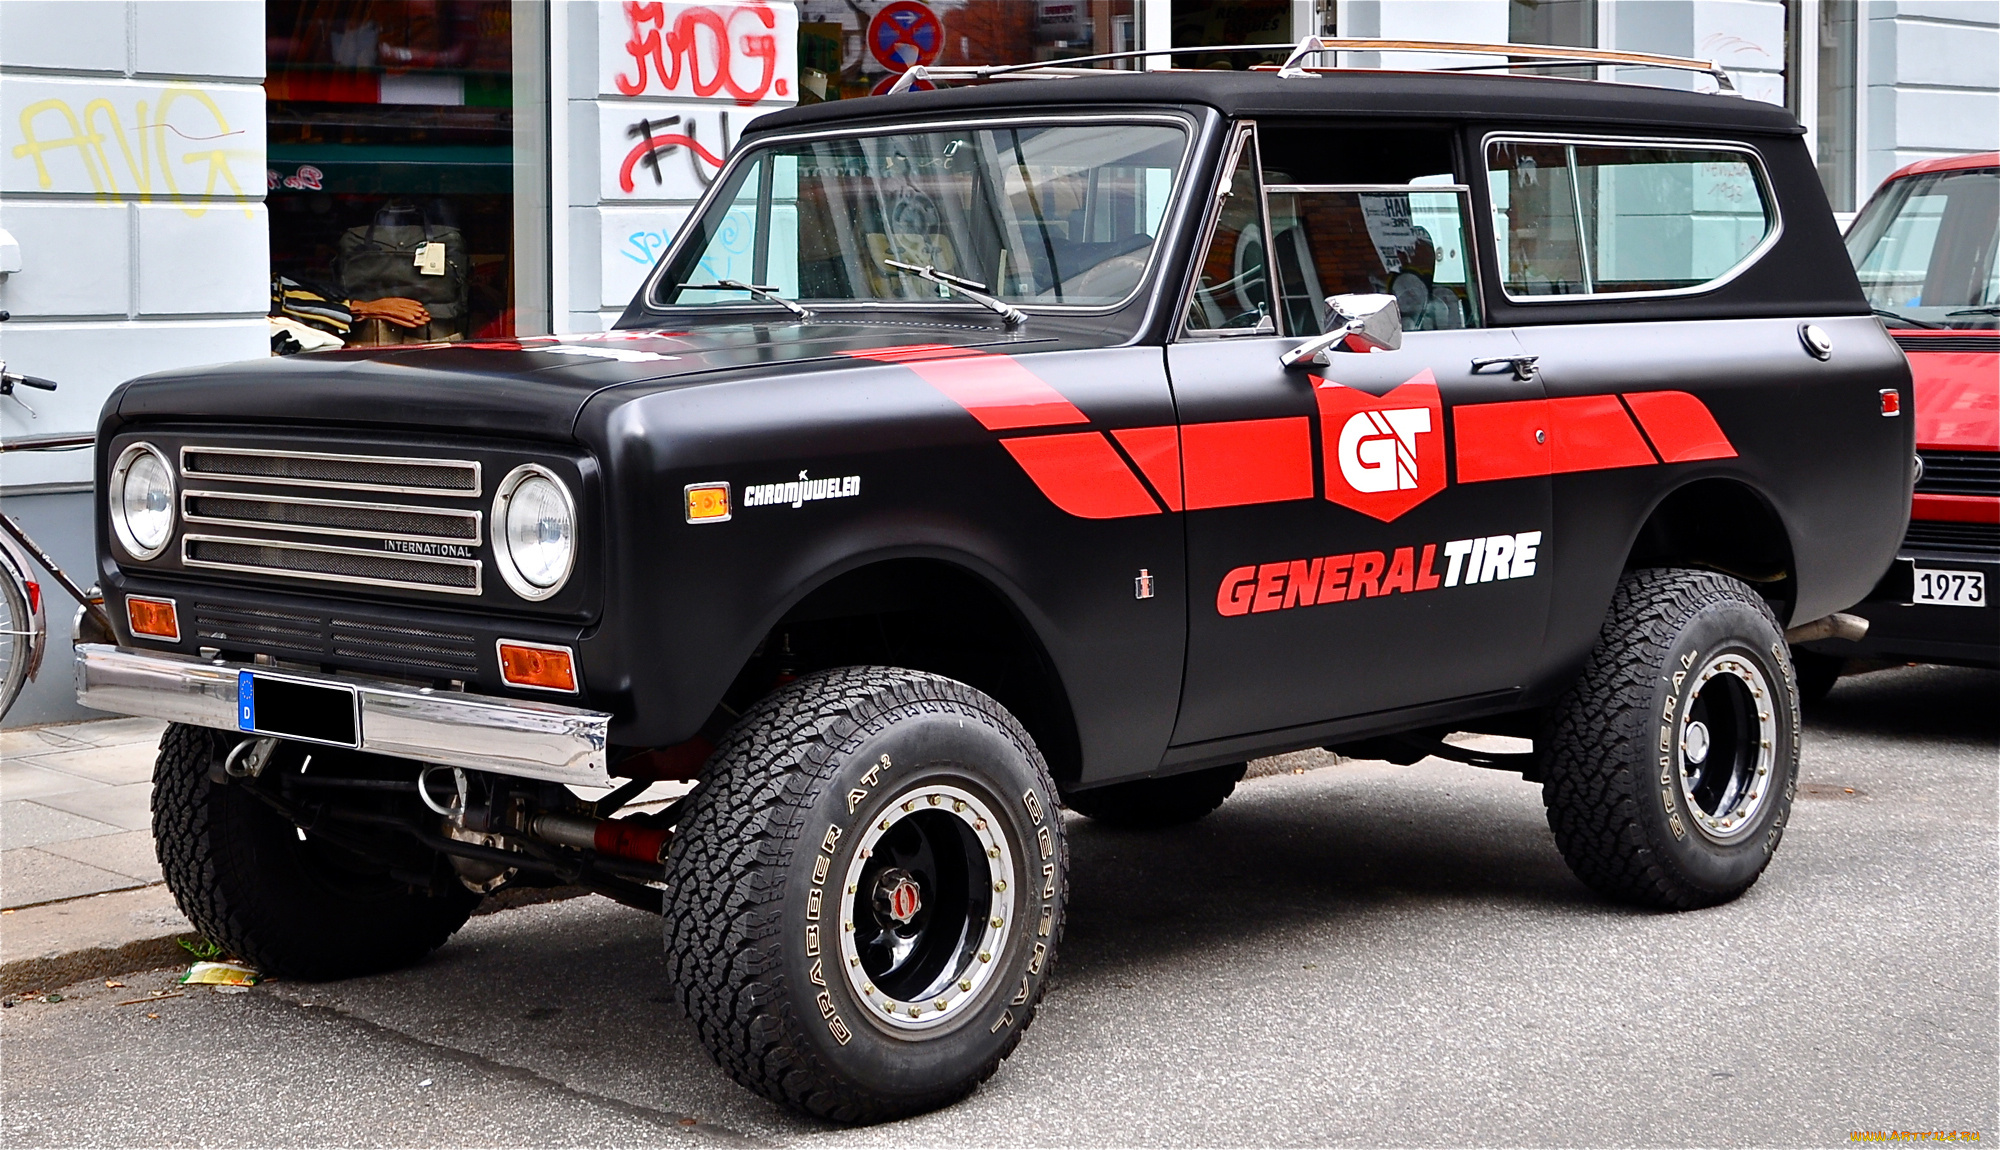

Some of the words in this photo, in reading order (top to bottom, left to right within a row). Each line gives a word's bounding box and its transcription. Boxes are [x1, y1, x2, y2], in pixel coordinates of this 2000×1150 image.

[1338, 407, 1431, 493] GT
[384, 540, 472, 558] INTERNATIONAL
[1921, 574, 1982, 602] 1973
[244, 706, 251, 720] D
[1659, 650, 1697, 841] GENERAL
[806, 823, 852, 1046] GRABBER
[990, 788, 1055, 1034] GENERAL
